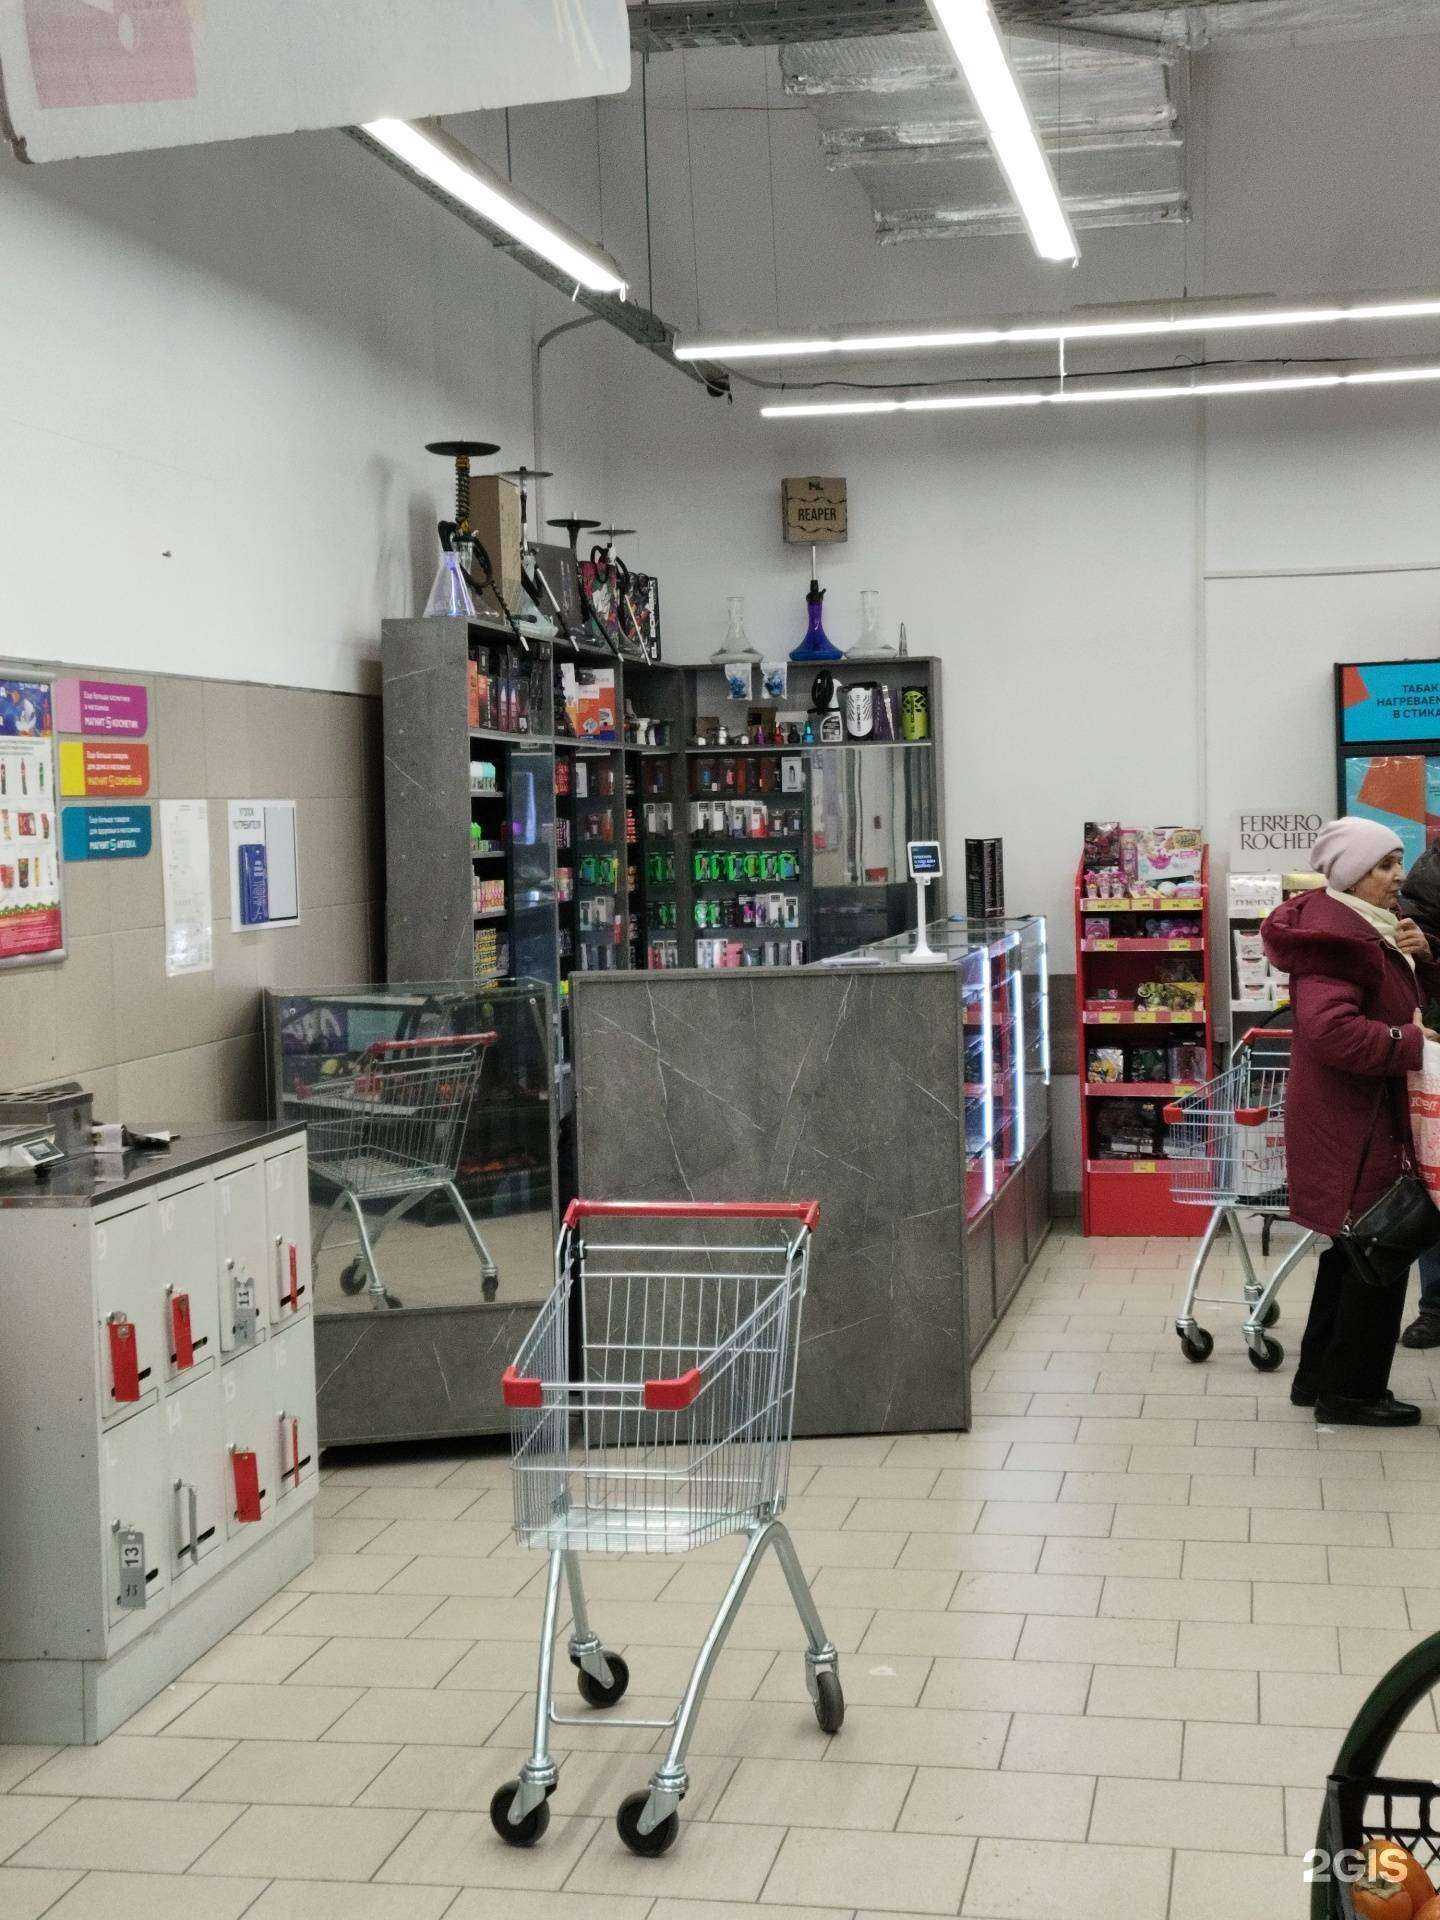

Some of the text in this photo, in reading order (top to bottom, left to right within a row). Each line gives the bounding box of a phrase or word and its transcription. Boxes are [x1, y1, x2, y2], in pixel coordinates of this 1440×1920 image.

[798, 508, 837, 521] REAPER
[1240, 814, 1322, 832] FERRERO
[97, 1228, 108, 1260] 9
[124, 1546, 140, 1568] 13
